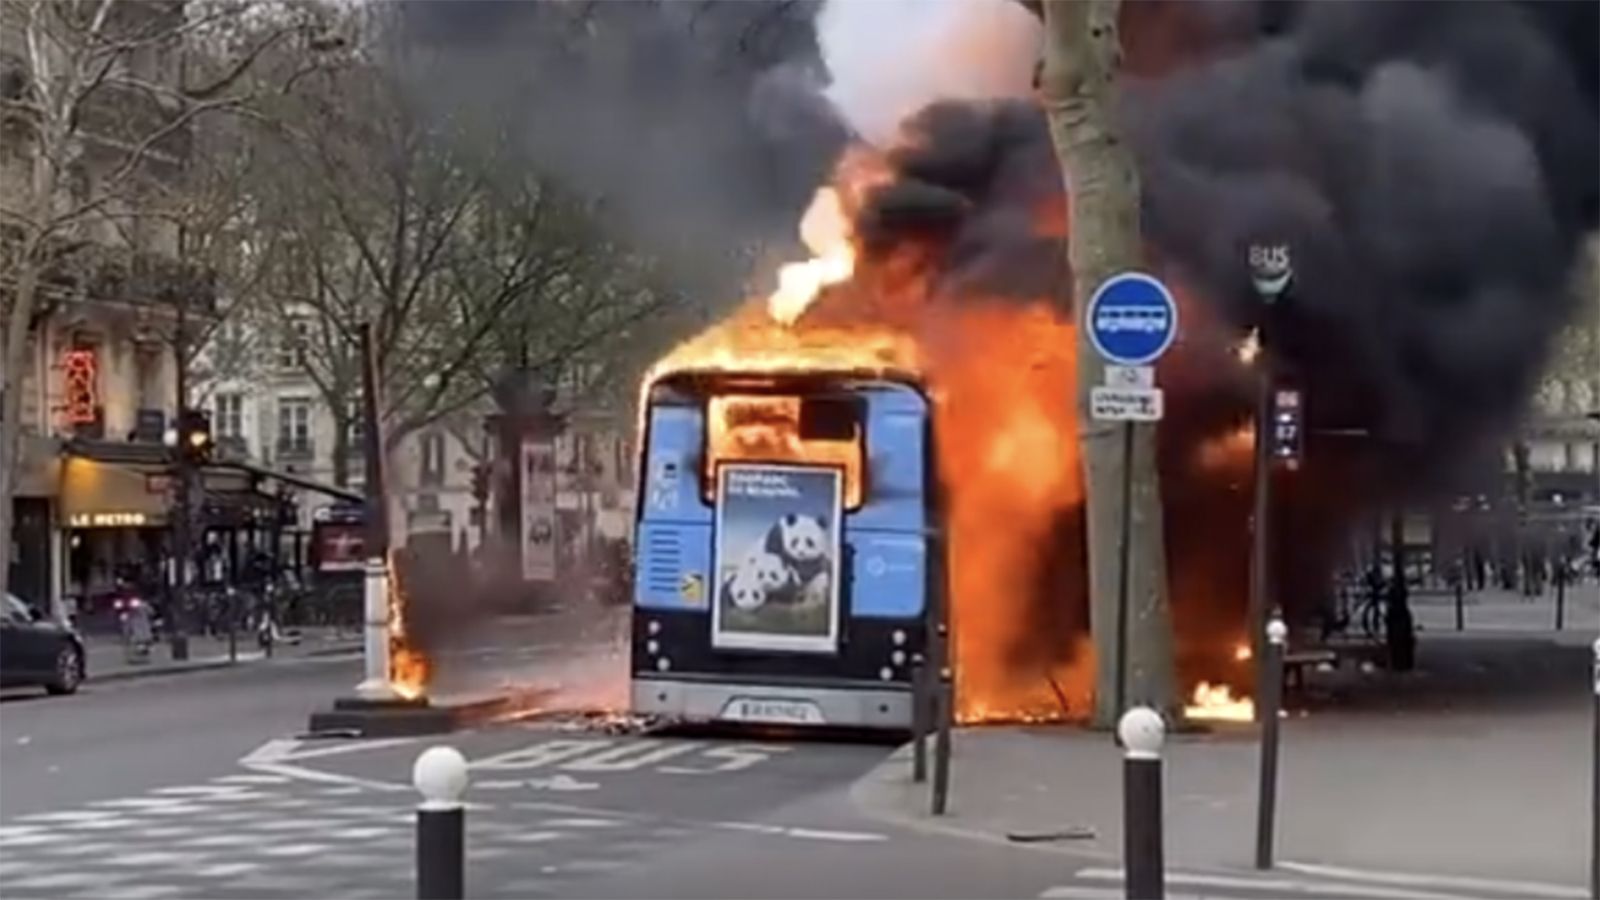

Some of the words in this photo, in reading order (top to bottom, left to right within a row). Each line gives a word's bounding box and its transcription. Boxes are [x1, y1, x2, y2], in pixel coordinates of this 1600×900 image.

[1249, 245, 1290, 270] BUS
[71, 512, 89, 527] LE
[467, 738, 796, 774] BUS
